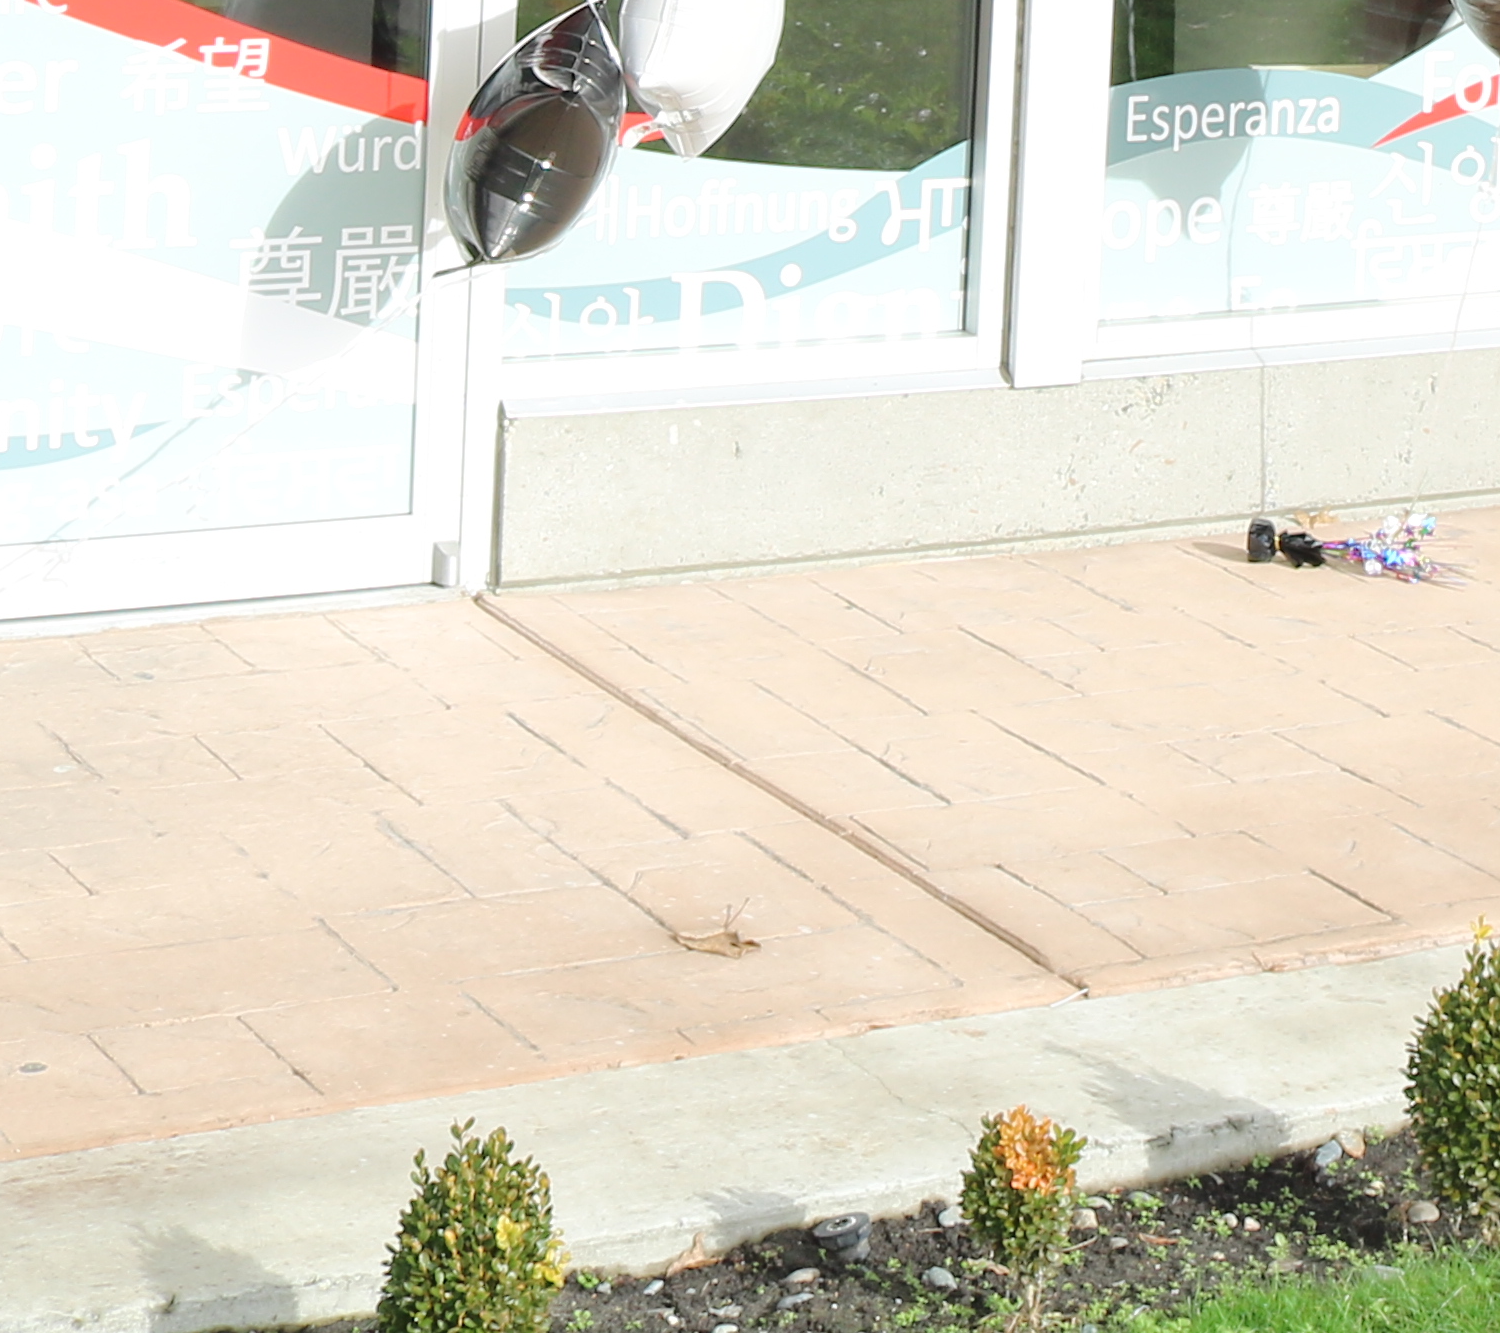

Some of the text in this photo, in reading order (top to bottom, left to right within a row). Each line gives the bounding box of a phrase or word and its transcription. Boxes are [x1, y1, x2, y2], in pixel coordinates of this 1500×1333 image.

[276, 121, 422, 176] Würd
[1126, 95, 1341, 152] Esperanza
[626, 177, 860, 242] Hoffnung
